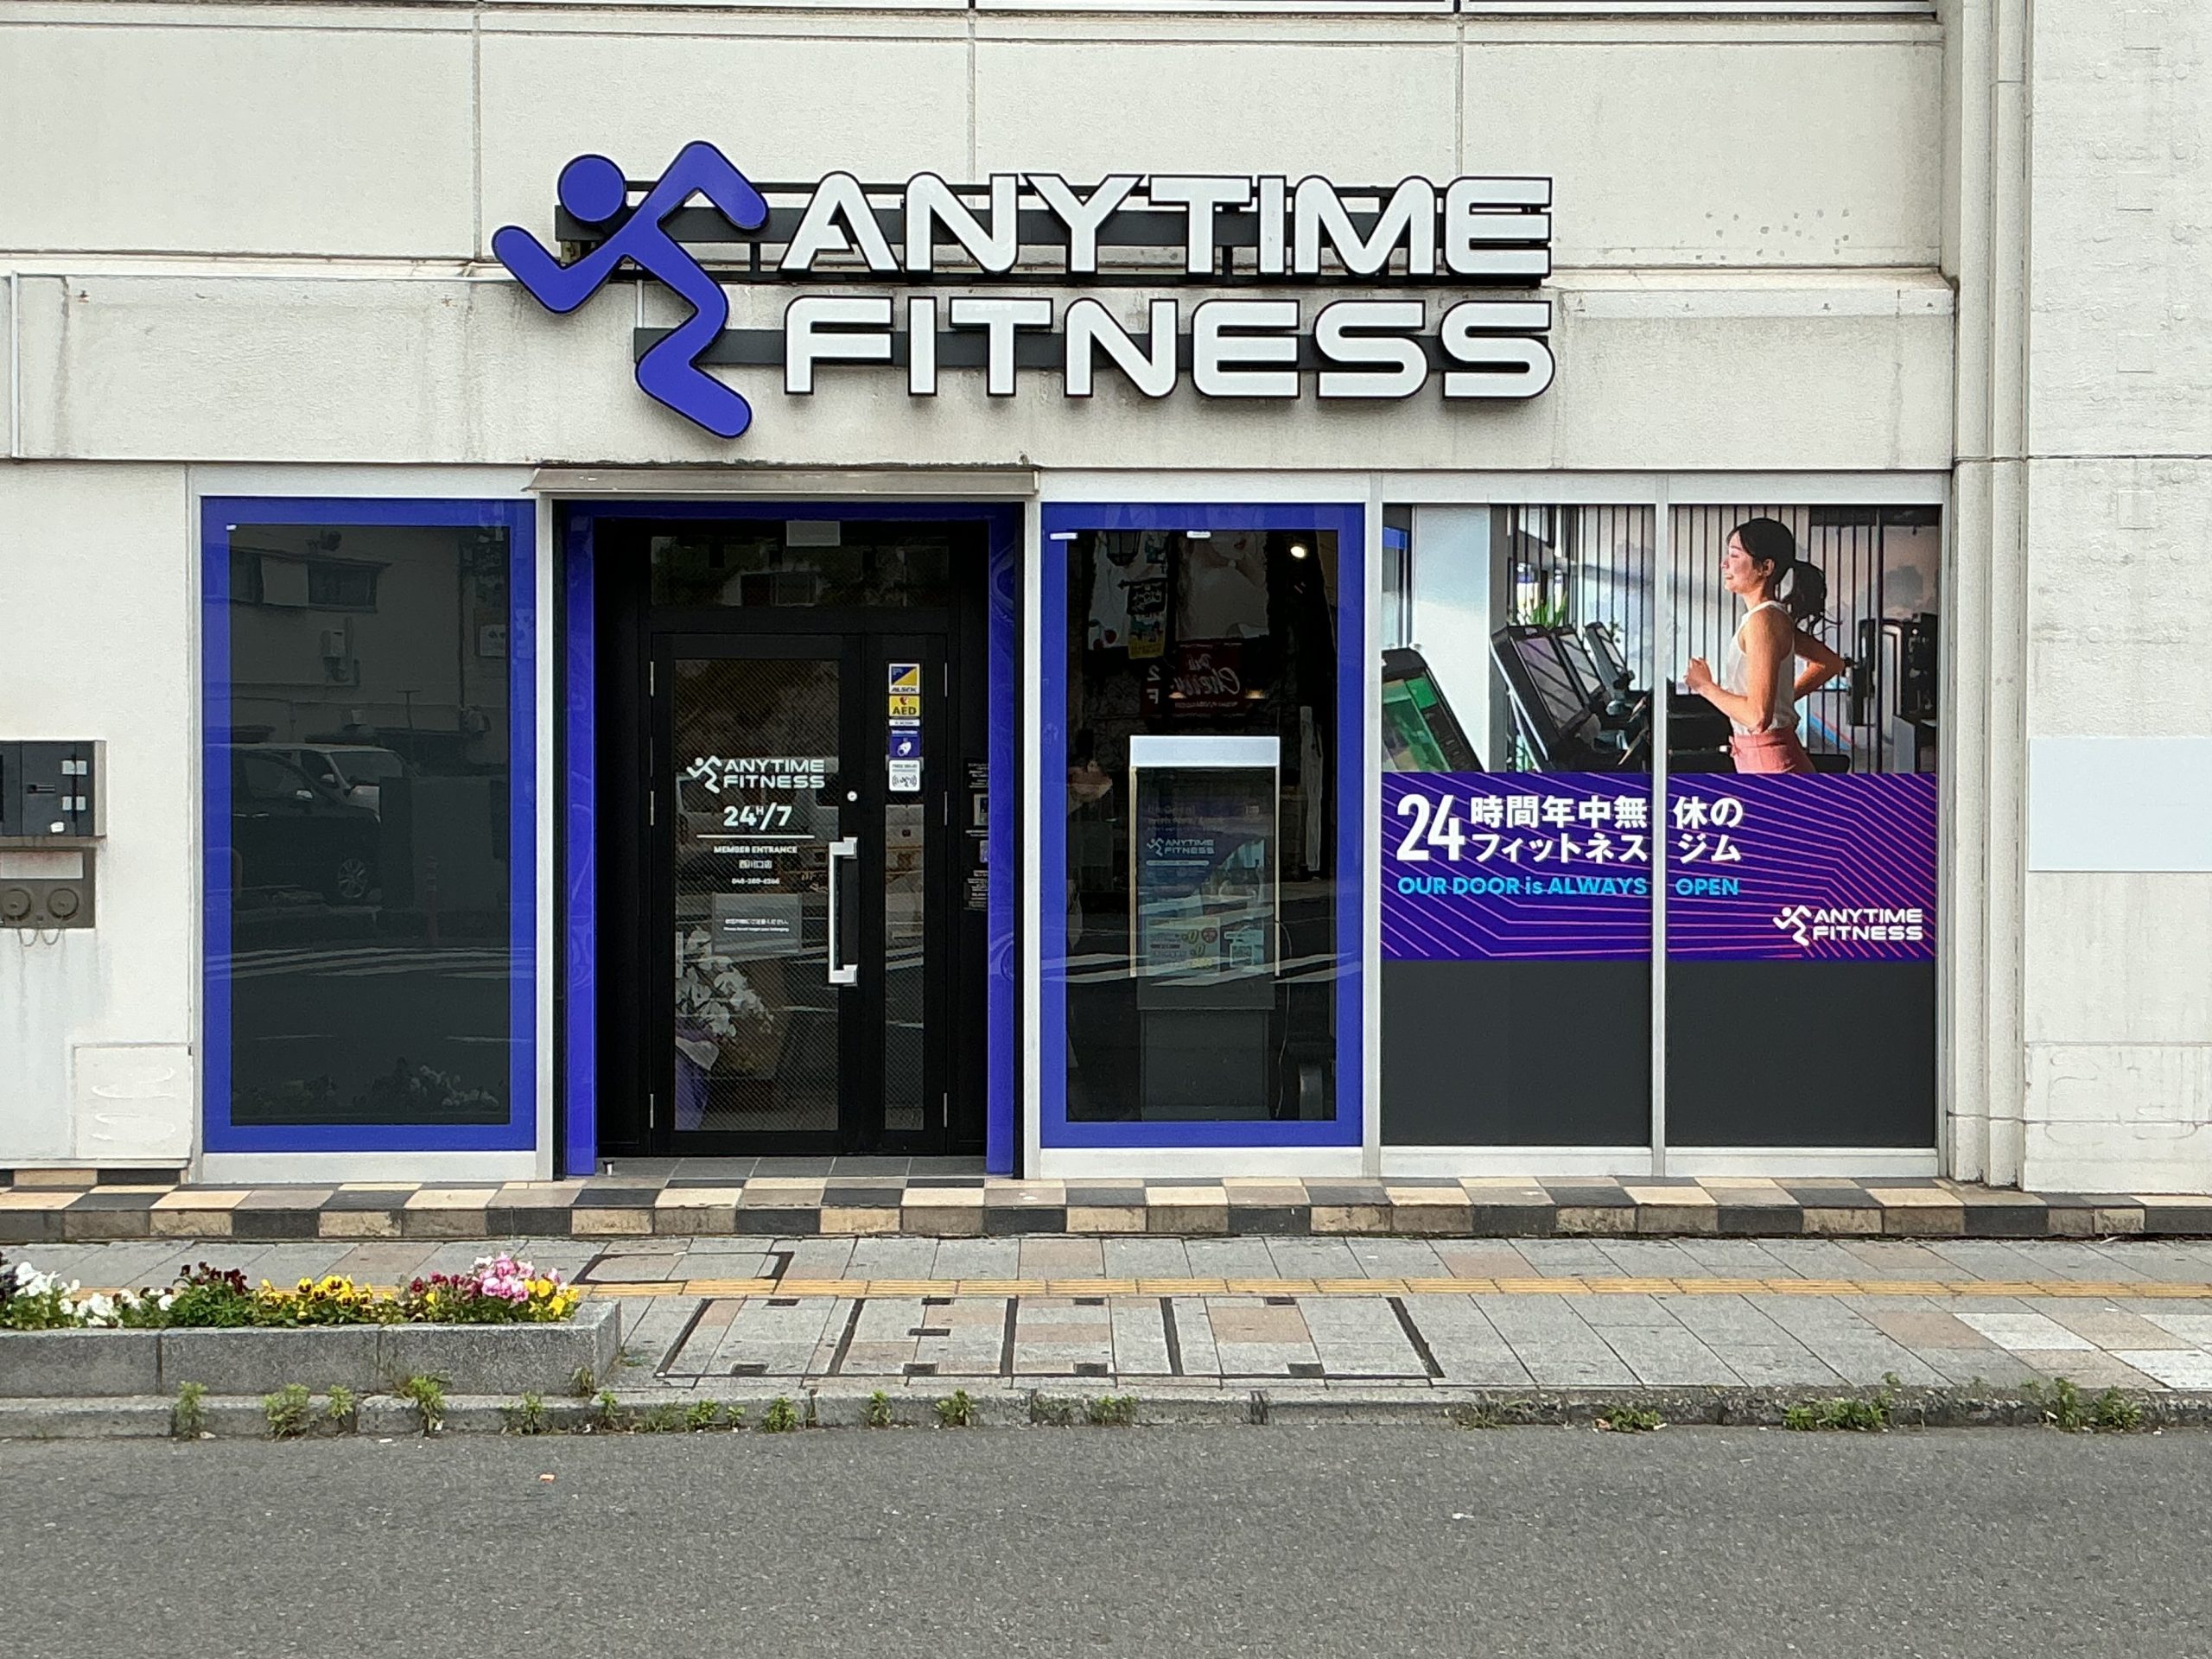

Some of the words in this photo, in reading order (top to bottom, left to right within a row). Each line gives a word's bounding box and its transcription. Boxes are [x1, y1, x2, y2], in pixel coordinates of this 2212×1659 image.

[779, 171, 1553, 276] ANYTIME
[784, 295, 1555, 399] FITNESS
[892, 706, 917, 715] AED
[724, 760, 825, 773] ANYTIME
[723, 775, 825, 788] FITNESS
[1395, 794, 1467, 861] 24
[1164, 846, 1215, 855] FITNESS
[1397, 876, 1452, 896] OUR
[1452, 876, 1520, 896] DOOR
[1525, 877, 1541, 896] is
[1548, 877, 1648, 897] ALWAYS
[1675, 878, 1739, 896] OPEN
[1814, 908, 1923, 924] ANYTIME
[1813, 925, 1924, 941] FITNESS
